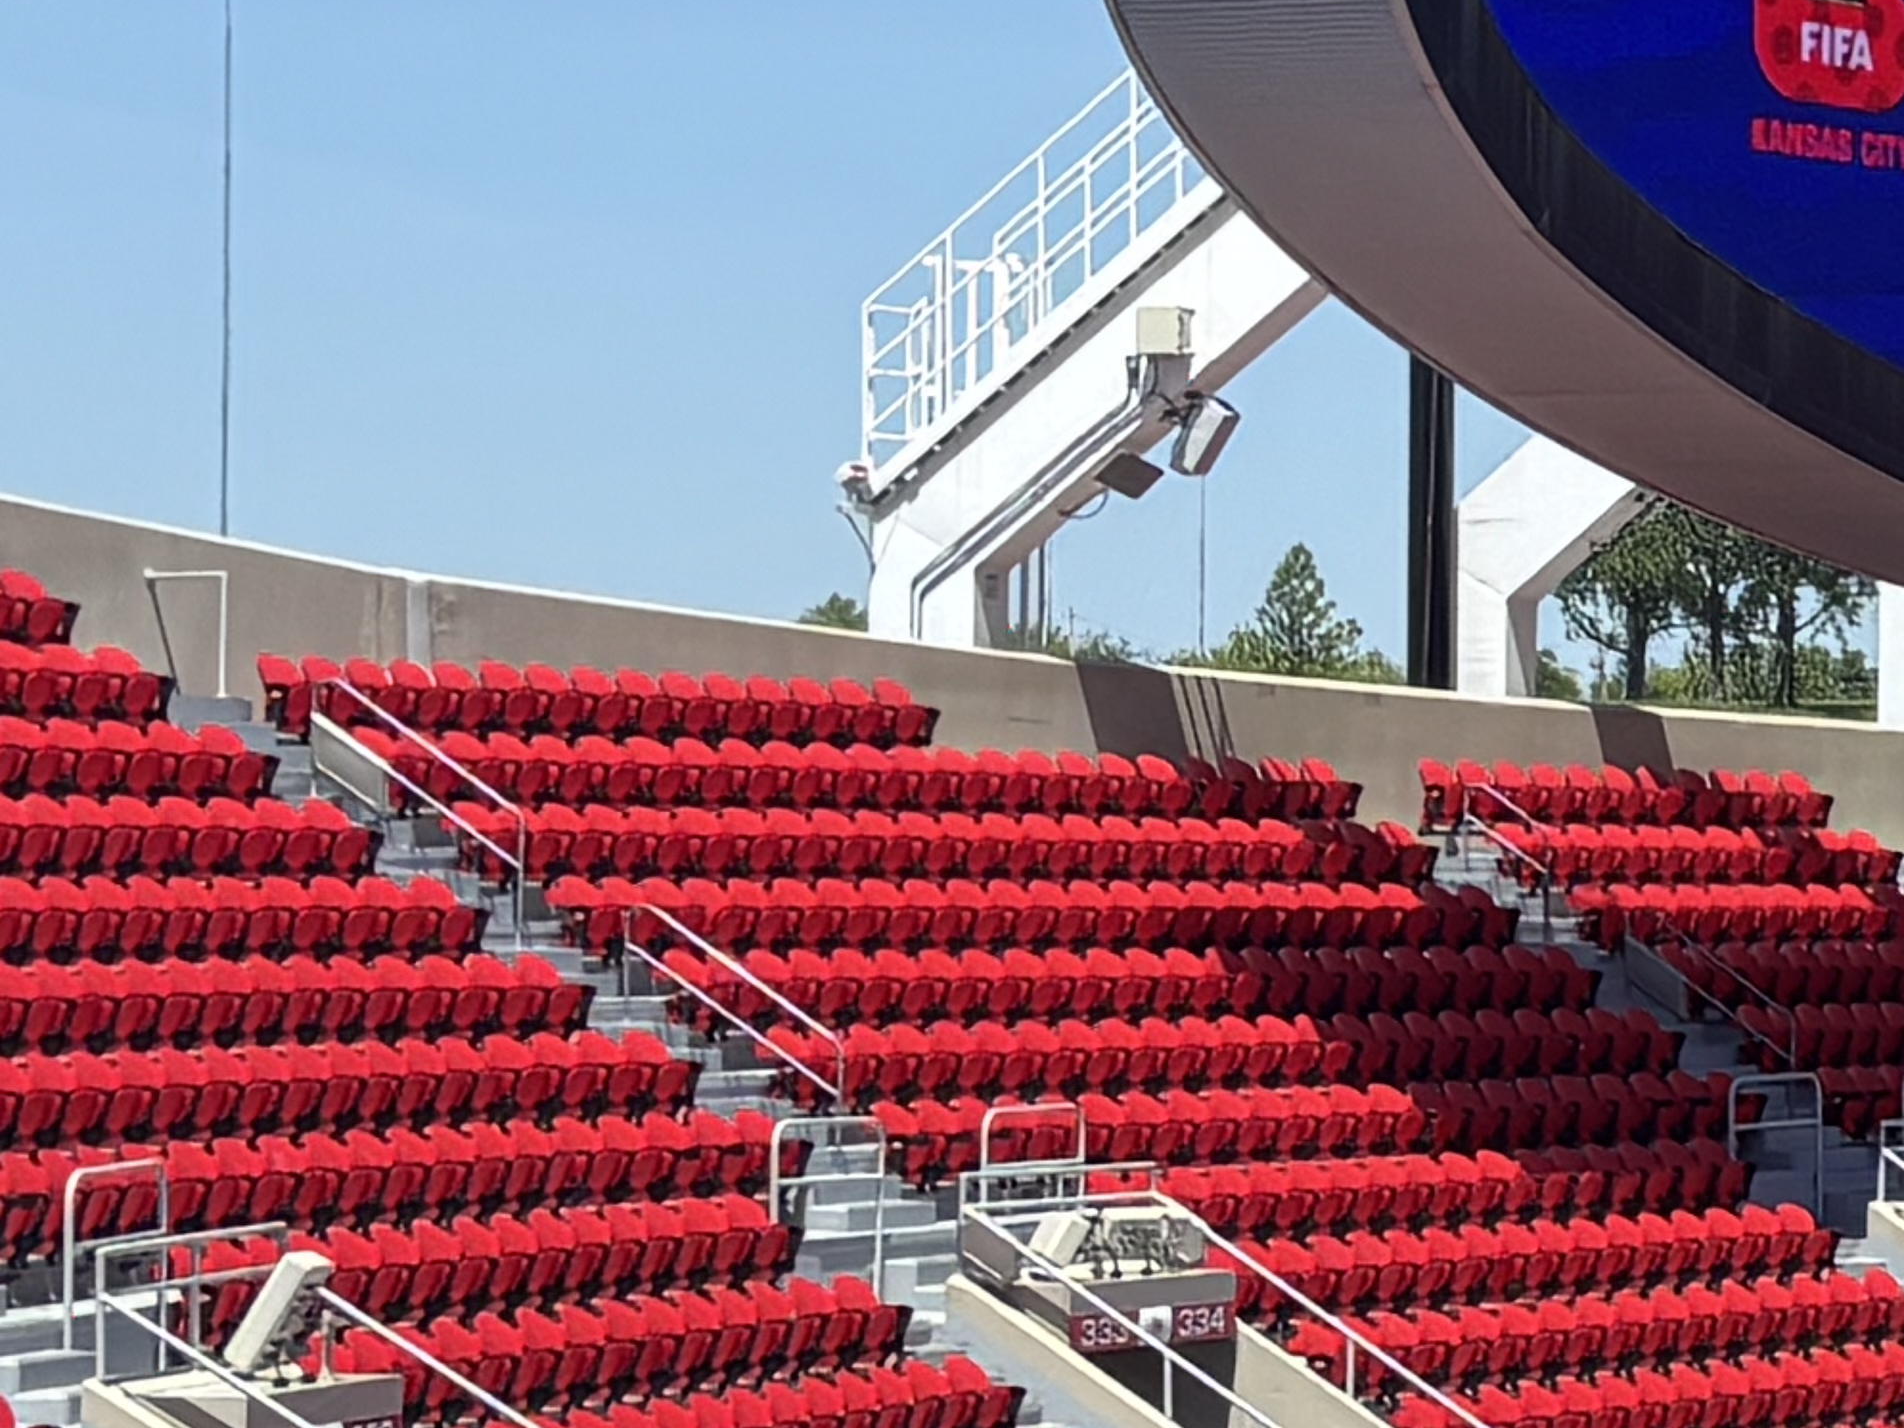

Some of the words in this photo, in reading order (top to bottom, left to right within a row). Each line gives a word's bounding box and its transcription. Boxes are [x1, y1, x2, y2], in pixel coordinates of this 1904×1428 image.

[1802, 20, 1873, 73] FIFA
[1751, 118, 1852, 162] KANSAS
[1177, 1306, 1225, 1338] 334
